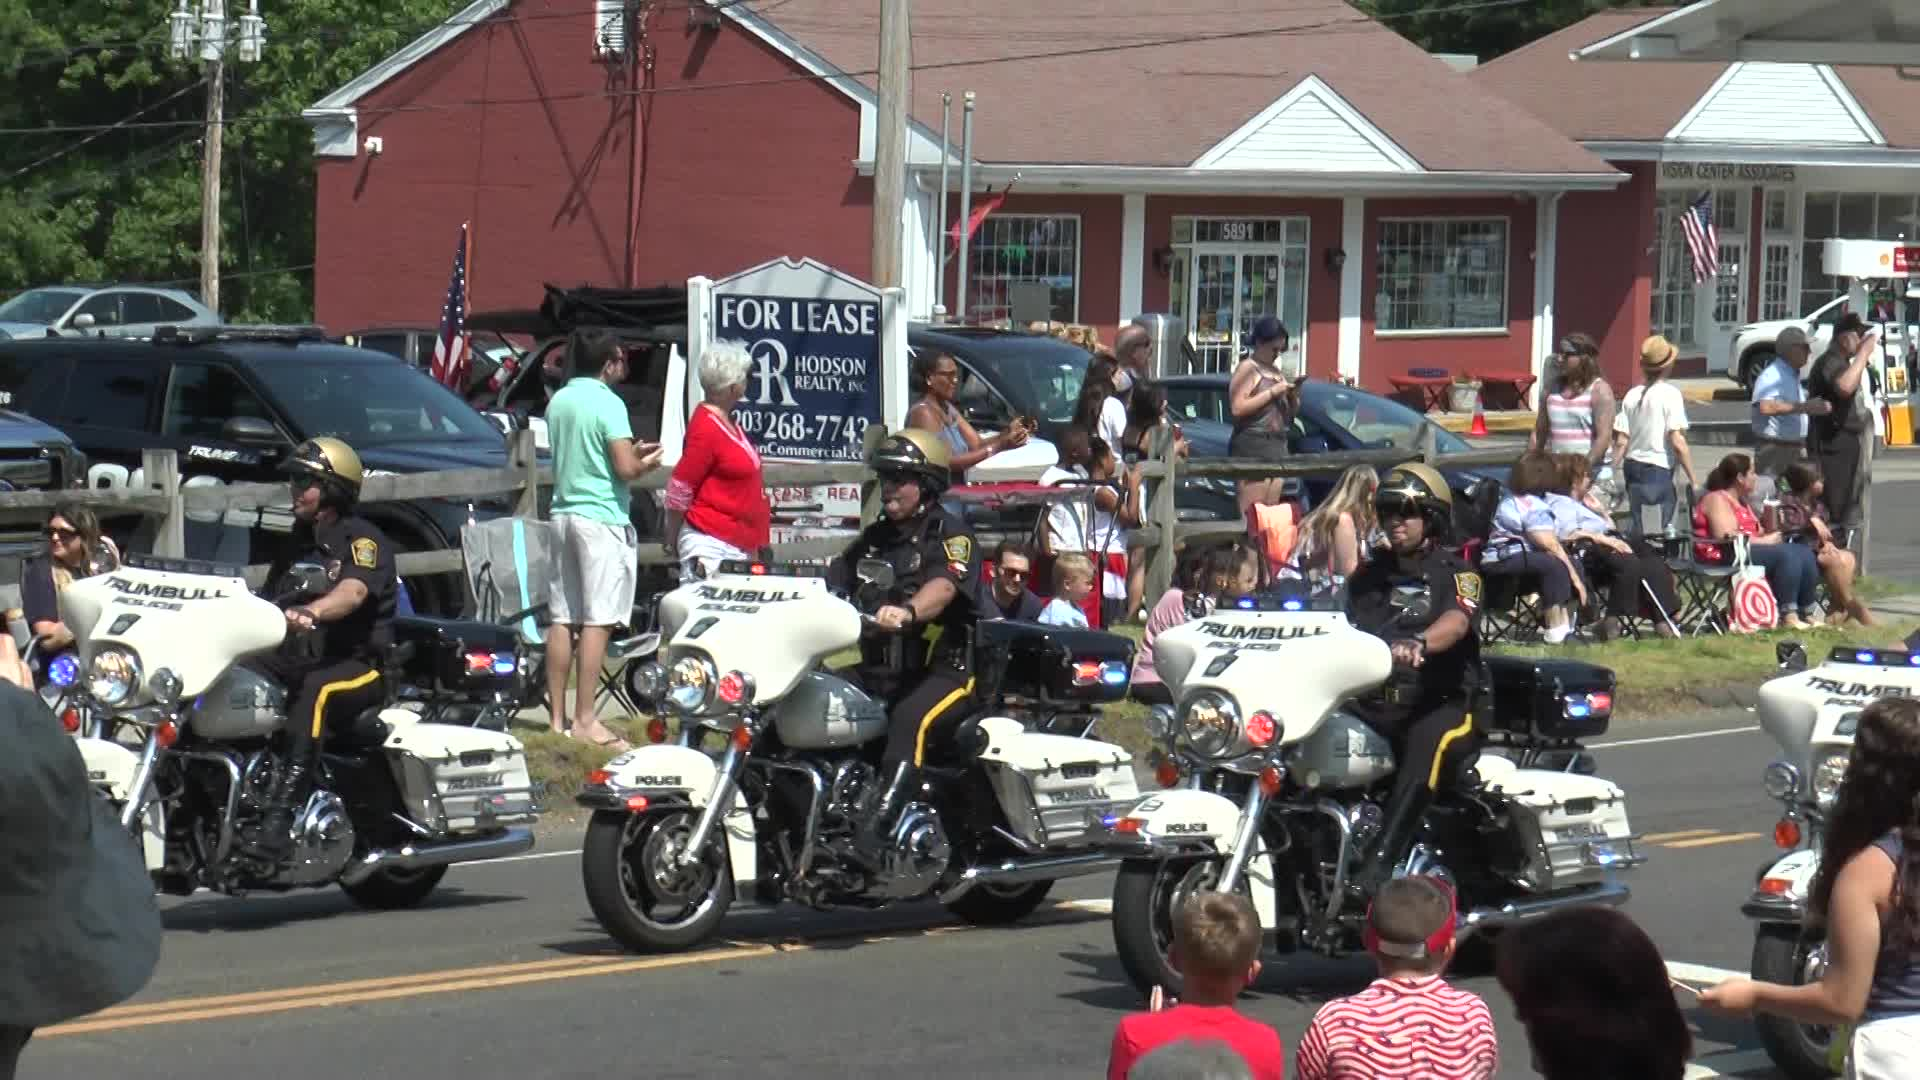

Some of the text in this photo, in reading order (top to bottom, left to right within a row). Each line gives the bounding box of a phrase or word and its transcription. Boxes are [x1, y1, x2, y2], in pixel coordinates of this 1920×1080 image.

[1696, 162, 1735, 179] CENTER
[1223, 223, 1254, 240] 5891
[722, 299, 875, 335] FOR LEASE
[795, 355, 866, 376] HODSON
[795, 375, 844, 394] REALTY,
[731, 409, 868, 444] 203 268-7743
[104, 575, 230, 600] TRUMBULL
[692, 585, 806, 603] TRUMBULL
[1195, 621, 1331, 640] TRUMBULL
[635, 775, 682, 786] POLICE
[1166, 823, 1208, 834] POLICE
